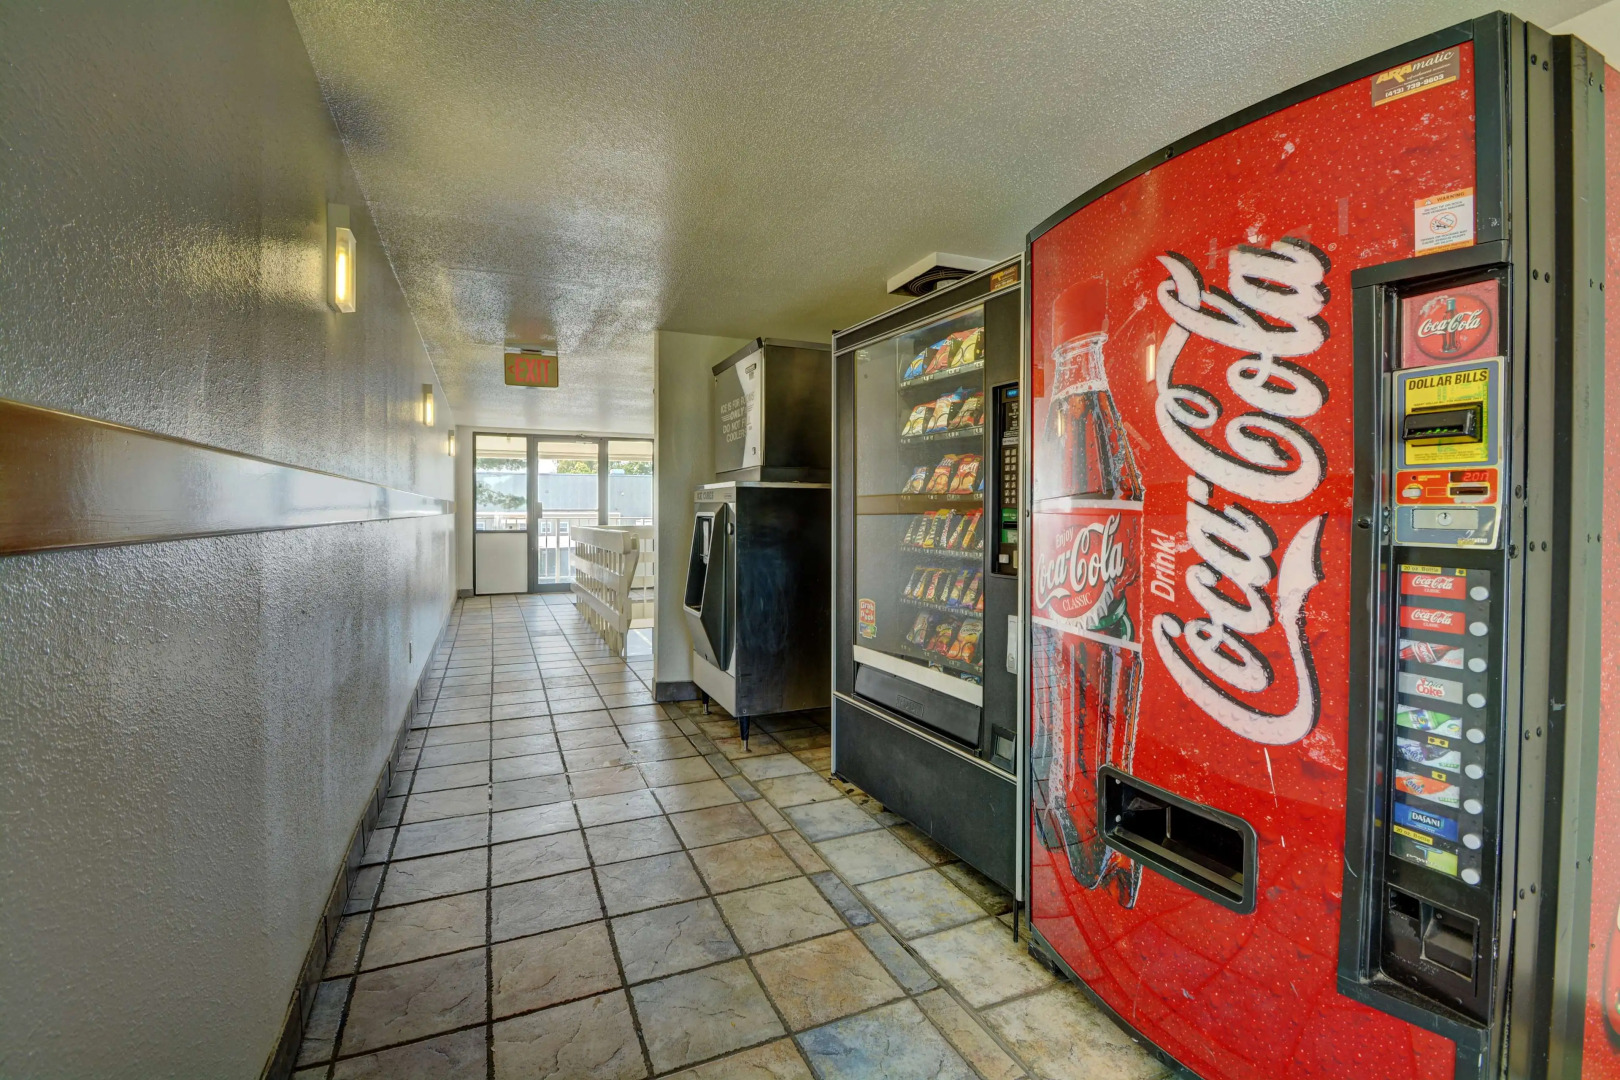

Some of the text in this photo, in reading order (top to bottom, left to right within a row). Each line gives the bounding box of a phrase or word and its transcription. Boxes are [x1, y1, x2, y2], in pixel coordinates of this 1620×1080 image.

[1436, 191, 1465, 202] WARNING
[1417, 308, 1483, 338] Coca-Cola
[514, 357, 551, 384] EXIT
[1408, 370, 1488, 390] DOLLAR BILLS
[1152, 238, 1330, 746] Coca-Cola
[1055, 526, 1075, 549] Enjoy
[1035, 512, 1125, 609] Coca-Cola
[1150, 528, 1175, 602] Drink!
[1411, 575, 1454, 590] Coca-Cola
[1062, 593, 1093, 612] CLASSIC
[1411, 609, 1454, 625] Coca-Cola
[1416, 683, 1443, 697] Coke
[1412, 812, 1440, 827] DASANI
